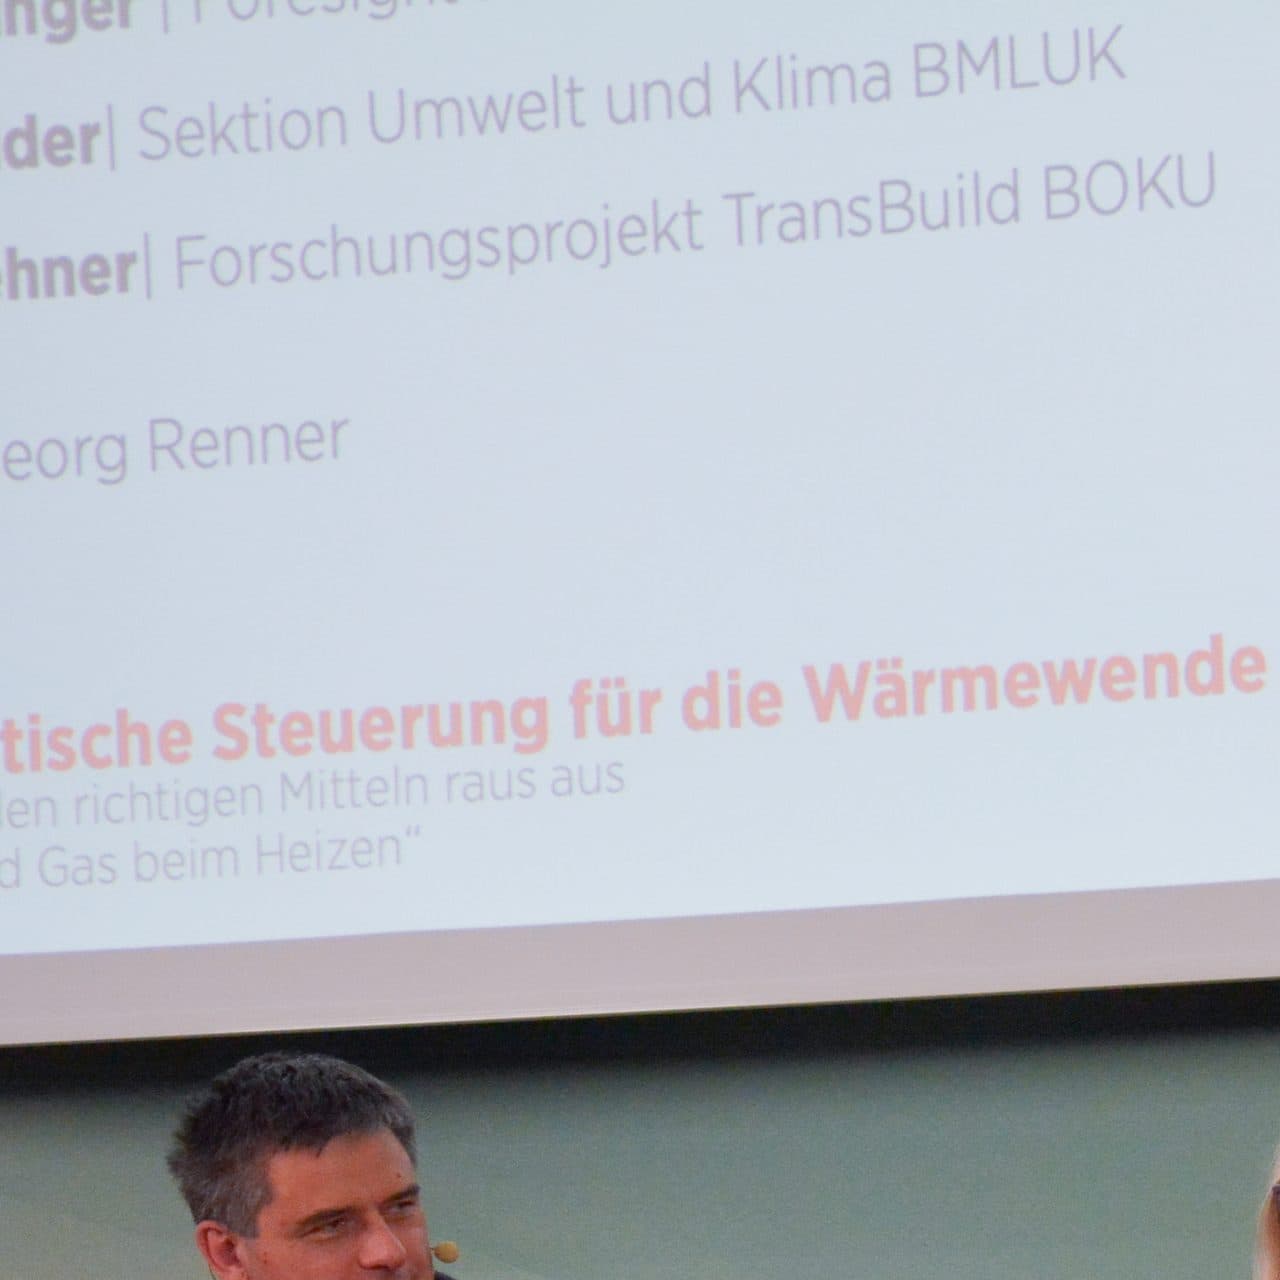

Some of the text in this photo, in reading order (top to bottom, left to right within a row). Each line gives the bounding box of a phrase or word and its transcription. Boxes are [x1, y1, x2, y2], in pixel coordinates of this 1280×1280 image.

[138, 98, 348, 162] Sektion
[366, 73, 586, 145] Umwelt
[606, 61, 712, 125] und
[733, 53, 891, 115] Klima
[913, 23, 1127, 99] BMLUK
[175, 196, 705, 290] Forschungsprojekt
[722, 167, 1021, 247] TransBuild
[1044, 150, 1217, 221] BOKU
[2, 416, 350, 486] eorg Renner
[0, 632, 1268, 775] tische Steuerung für die Wärmewende
[73, 778, 265, 827] richtigen
[279, 765, 430, 813] Mitteln
[446, 765, 538, 802] raus
[550, 760, 626, 797] aus
[38, 845, 117, 888] Gas
[134, 841, 240, 883] beim
